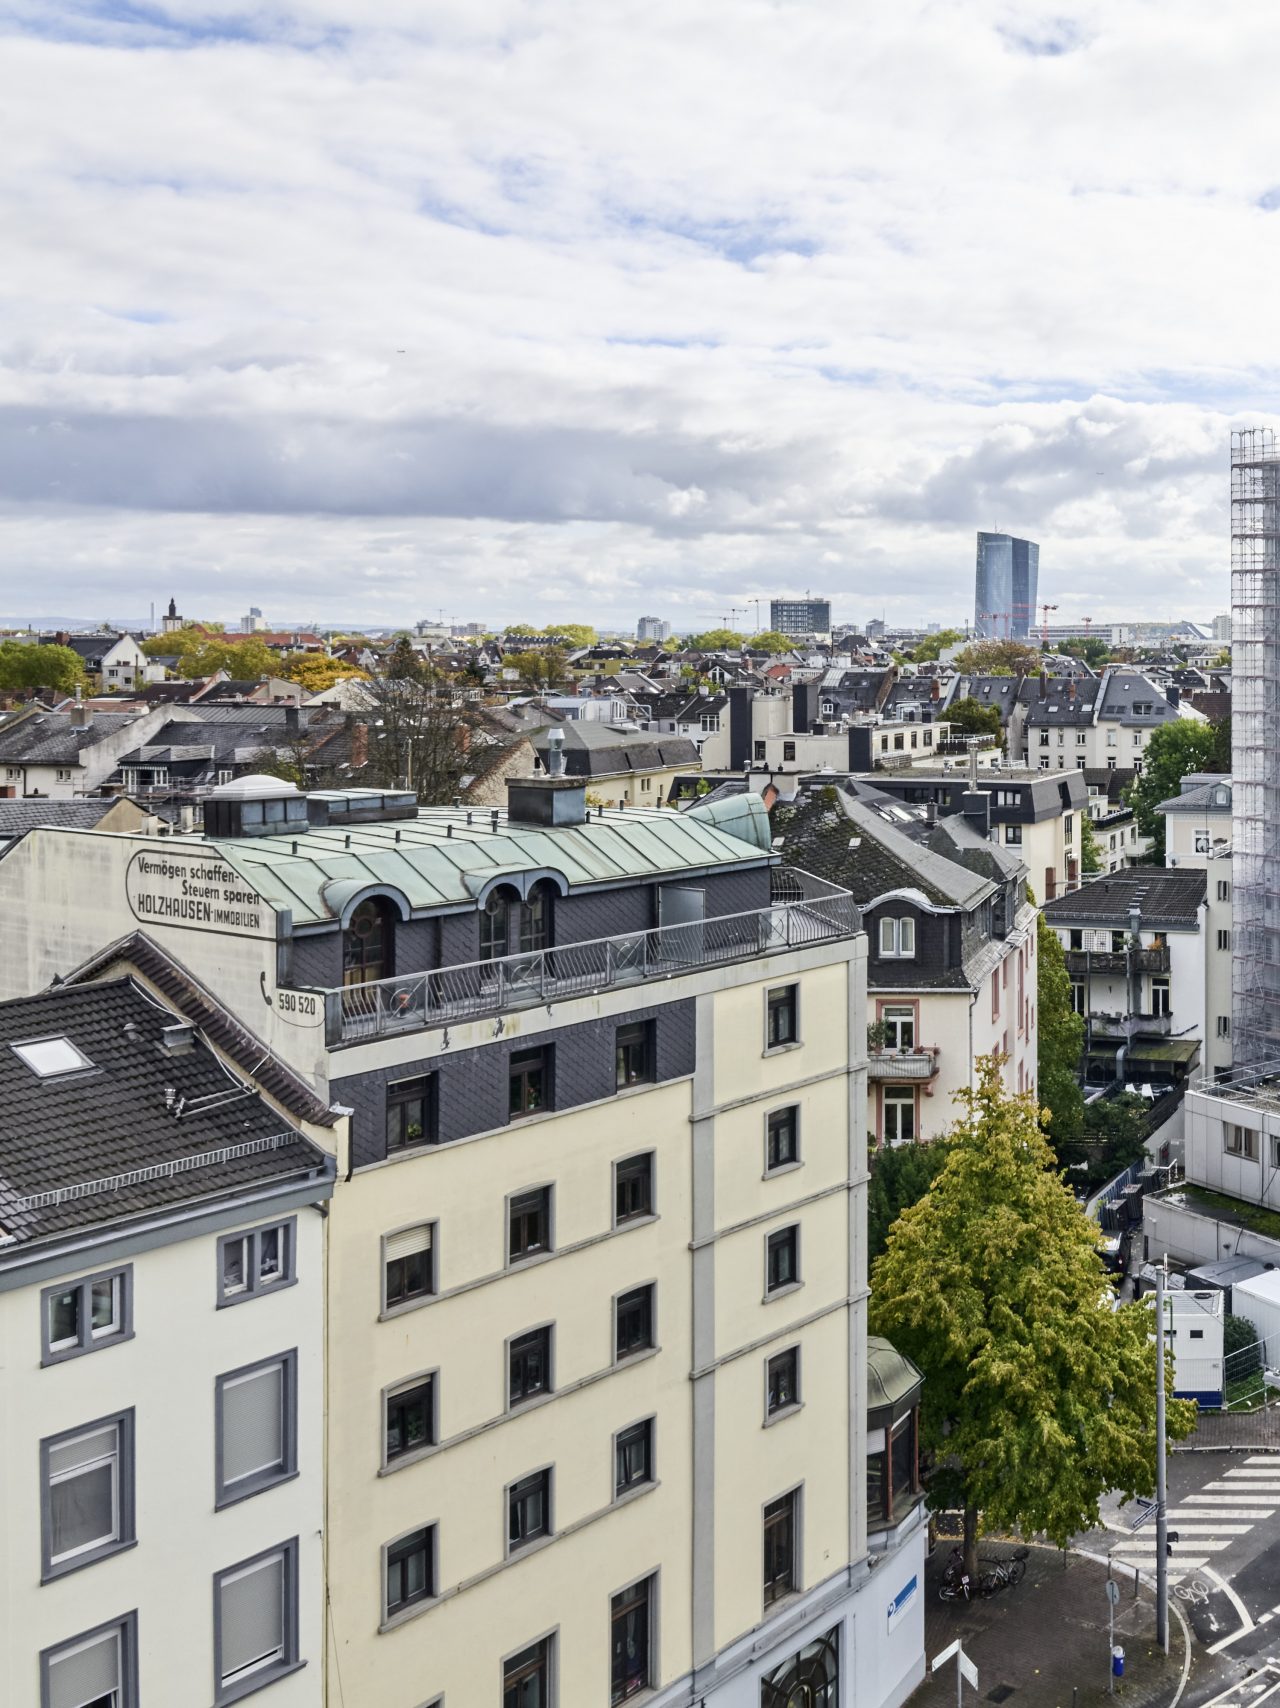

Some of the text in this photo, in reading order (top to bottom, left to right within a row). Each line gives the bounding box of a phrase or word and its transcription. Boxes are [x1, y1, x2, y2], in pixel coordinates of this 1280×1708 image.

[137, 856, 240, 883] Vermögen schaffen-
[181, 879, 260, 905] Steuern sparen
[279, 992, 316, 1015] 590 520
